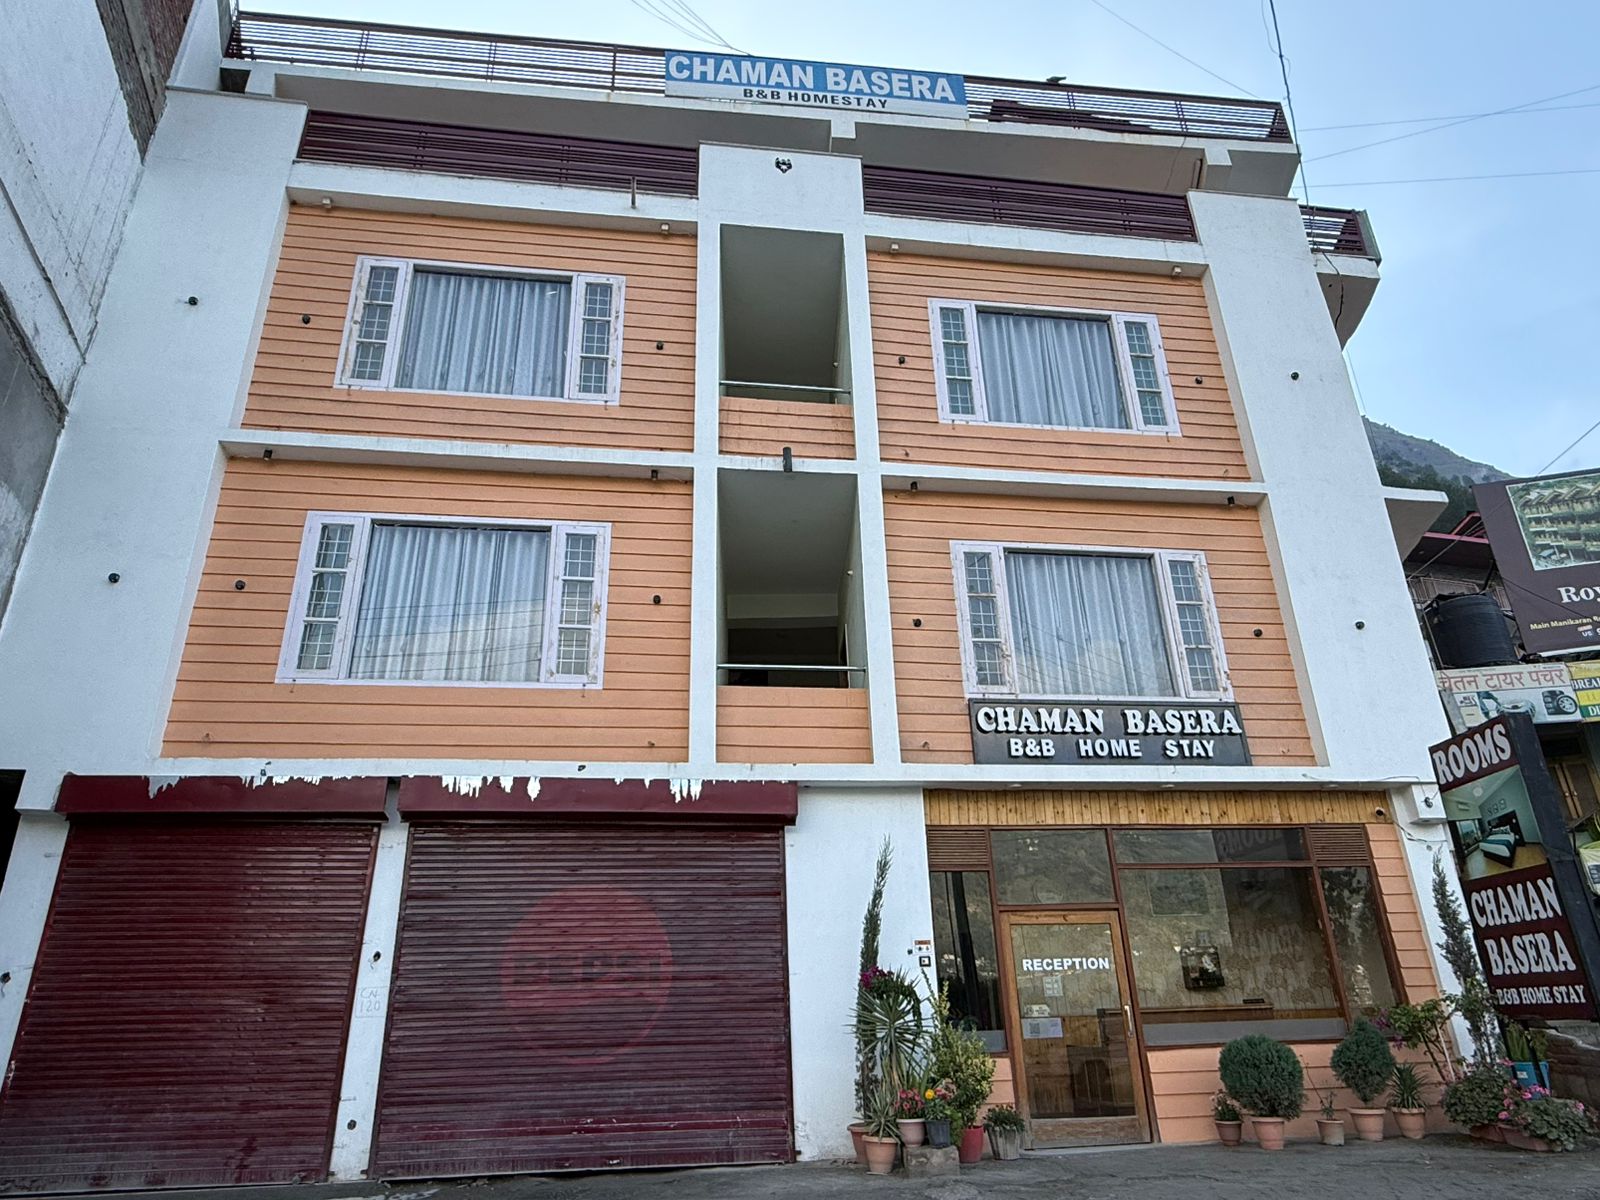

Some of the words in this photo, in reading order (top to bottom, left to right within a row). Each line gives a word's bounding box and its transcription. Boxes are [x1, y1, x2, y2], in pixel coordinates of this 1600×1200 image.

[668, 54, 814, 89] CHAMAN
[825, 68, 956, 102] BASERA
[743, 88, 781, 101] B&B
[788, 91, 888, 109] HOMESTAY
[1530, 622, 1550, 630] Main
[1550, 617, 1593, 627] Manikaran
[1482, 672, 1524, 690] टायर
[976, 706, 1104, 733] CHAMAN
[1123, 708, 1243, 735] BASERA
[1009, 738, 1056, 758] B&B
[1079, 738, 1143, 758] HOME
[1164, 739, 1215, 758] STAY
[1432, 723, 1512, 785] ROOMS
[1471, 877, 1563, 929] CHAMAN
[1484, 929, 1576, 977] BASERA
[1022, 957, 1110, 971] RECEPTION
[1519, 987, 1553, 1005] HOME
[1553, 984, 1587, 1004] STAY
